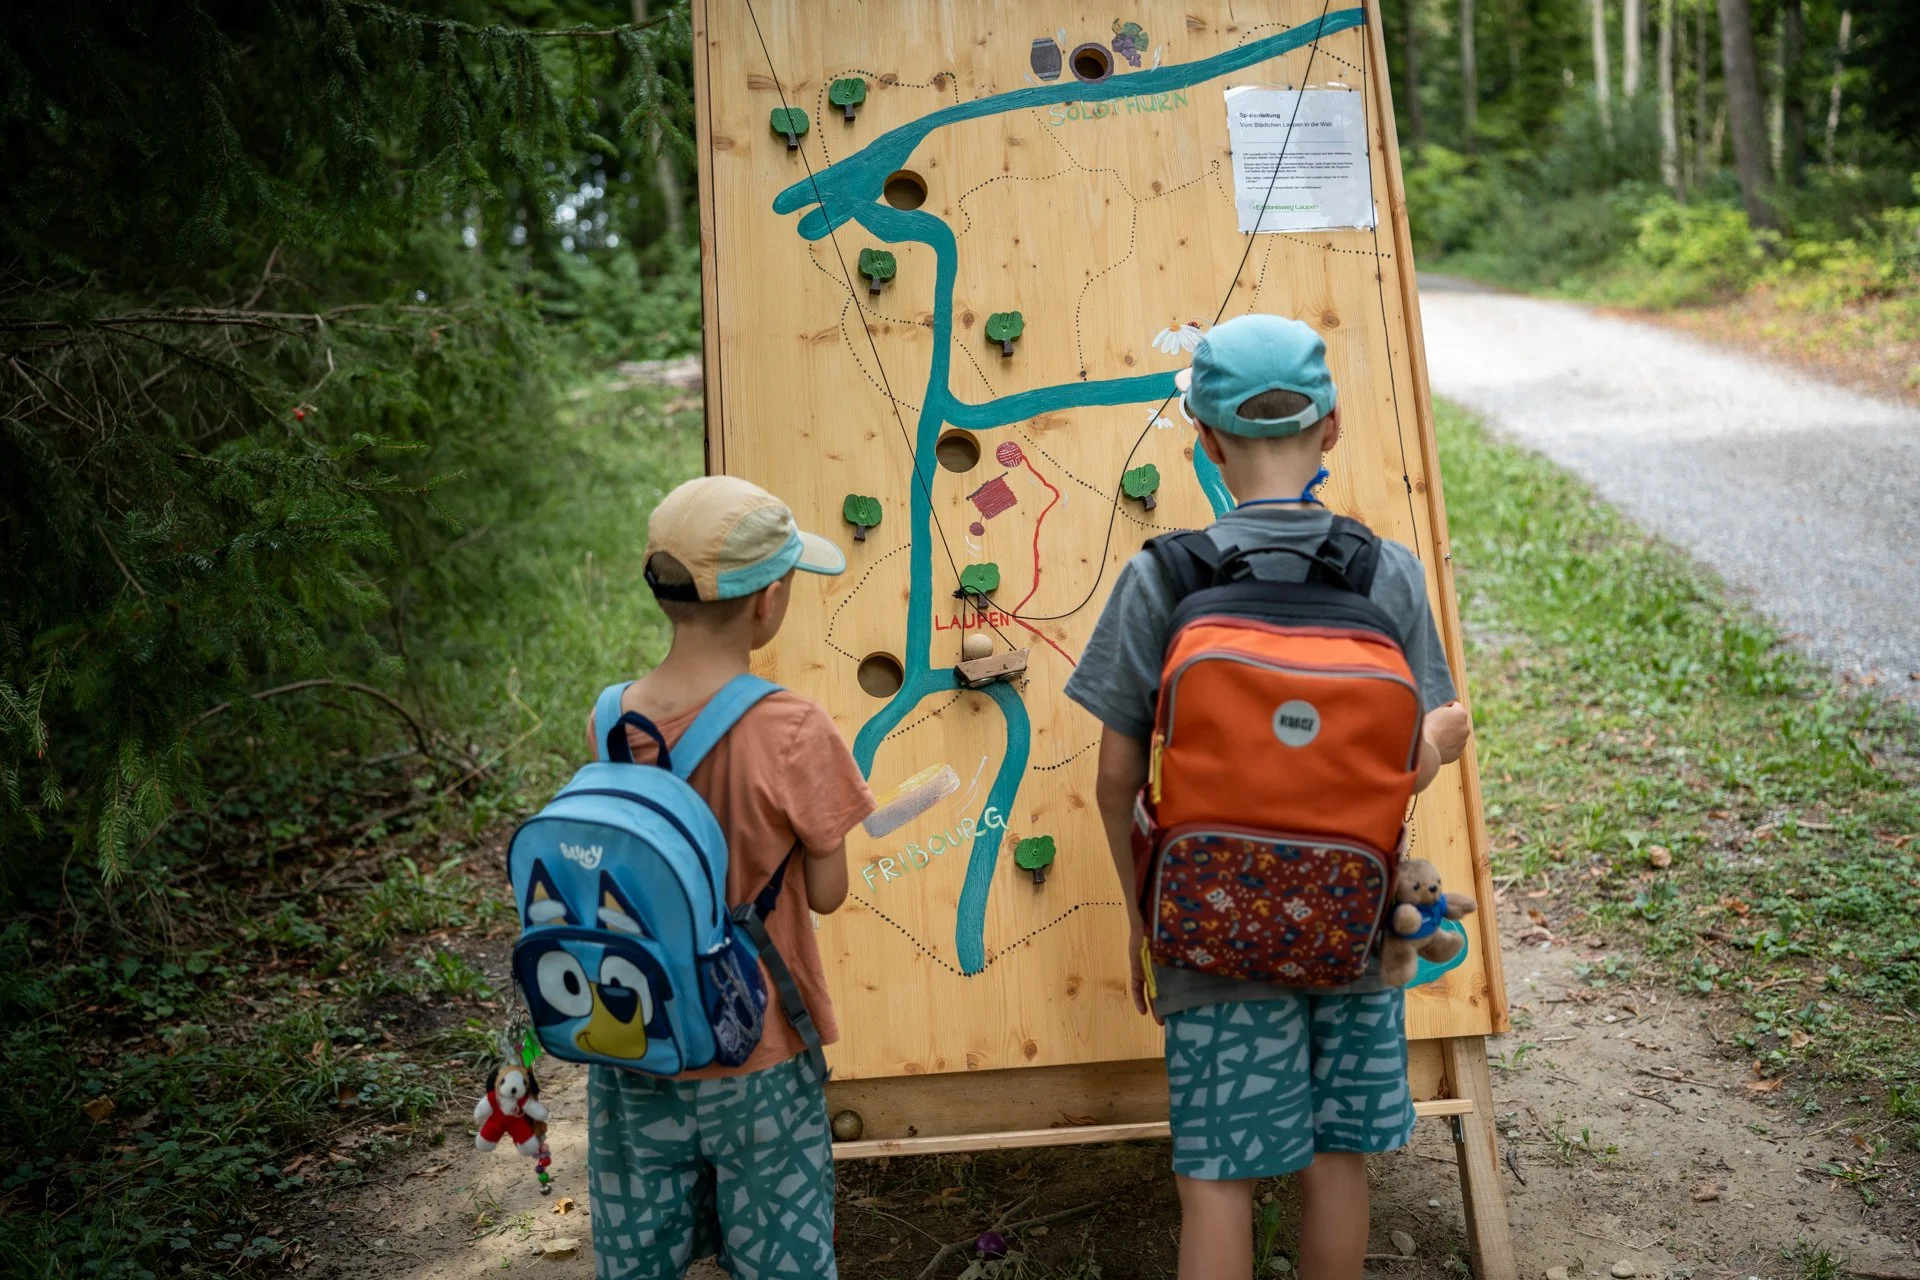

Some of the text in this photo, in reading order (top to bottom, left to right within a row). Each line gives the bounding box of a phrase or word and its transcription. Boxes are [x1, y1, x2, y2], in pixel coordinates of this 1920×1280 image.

[1049, 84, 1189, 126] SOLOTHURN
[935, 611, 1010, 631] LAUPEN
[861, 806, 1010, 894] FRIBOURG
